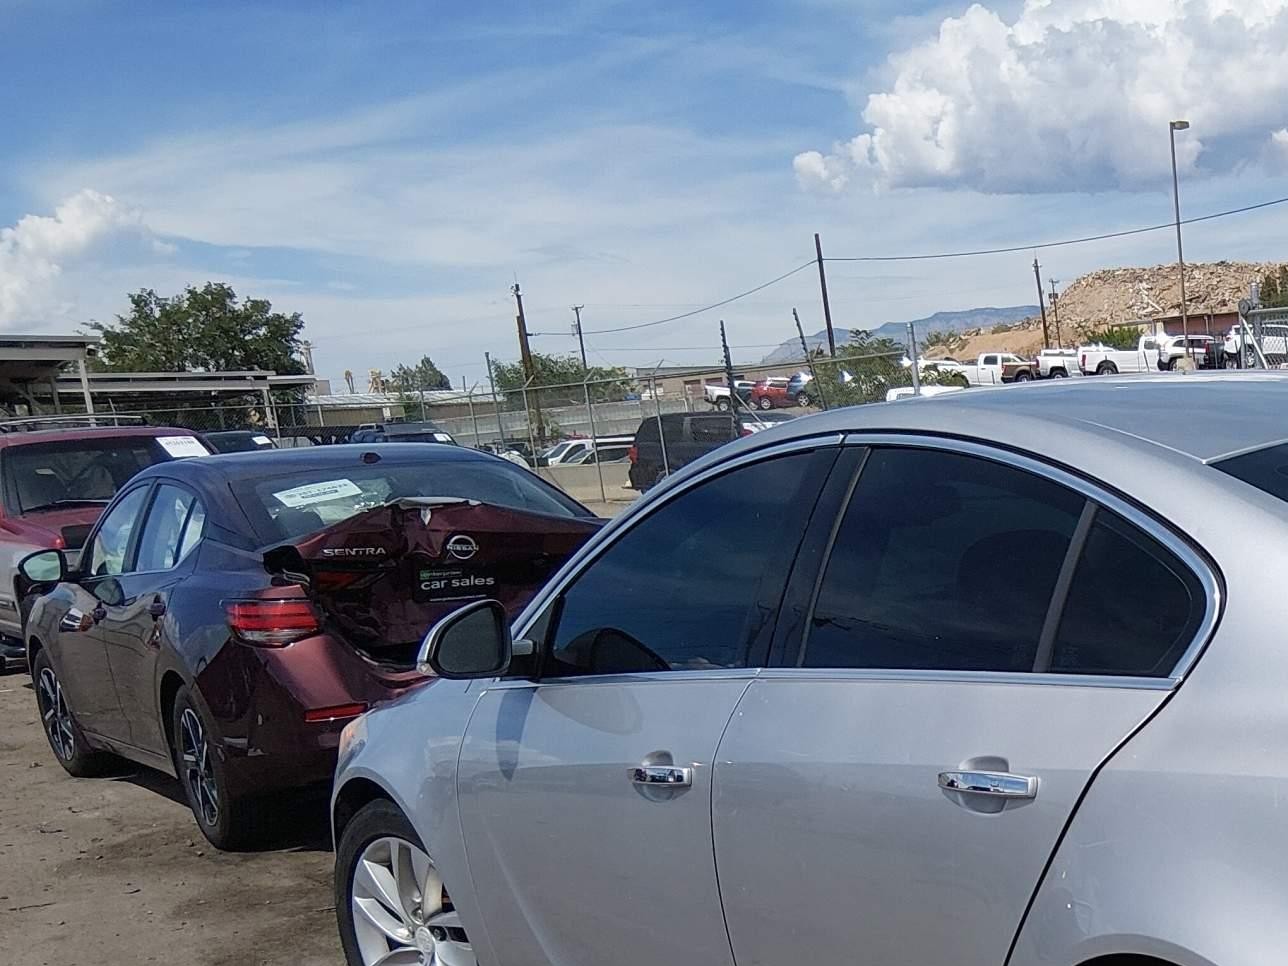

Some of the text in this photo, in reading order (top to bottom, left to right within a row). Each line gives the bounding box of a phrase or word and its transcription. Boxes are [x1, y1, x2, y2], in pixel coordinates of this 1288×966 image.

[322, 547, 386, 557] SENTRA
[420, 575, 495, 591] car sales
